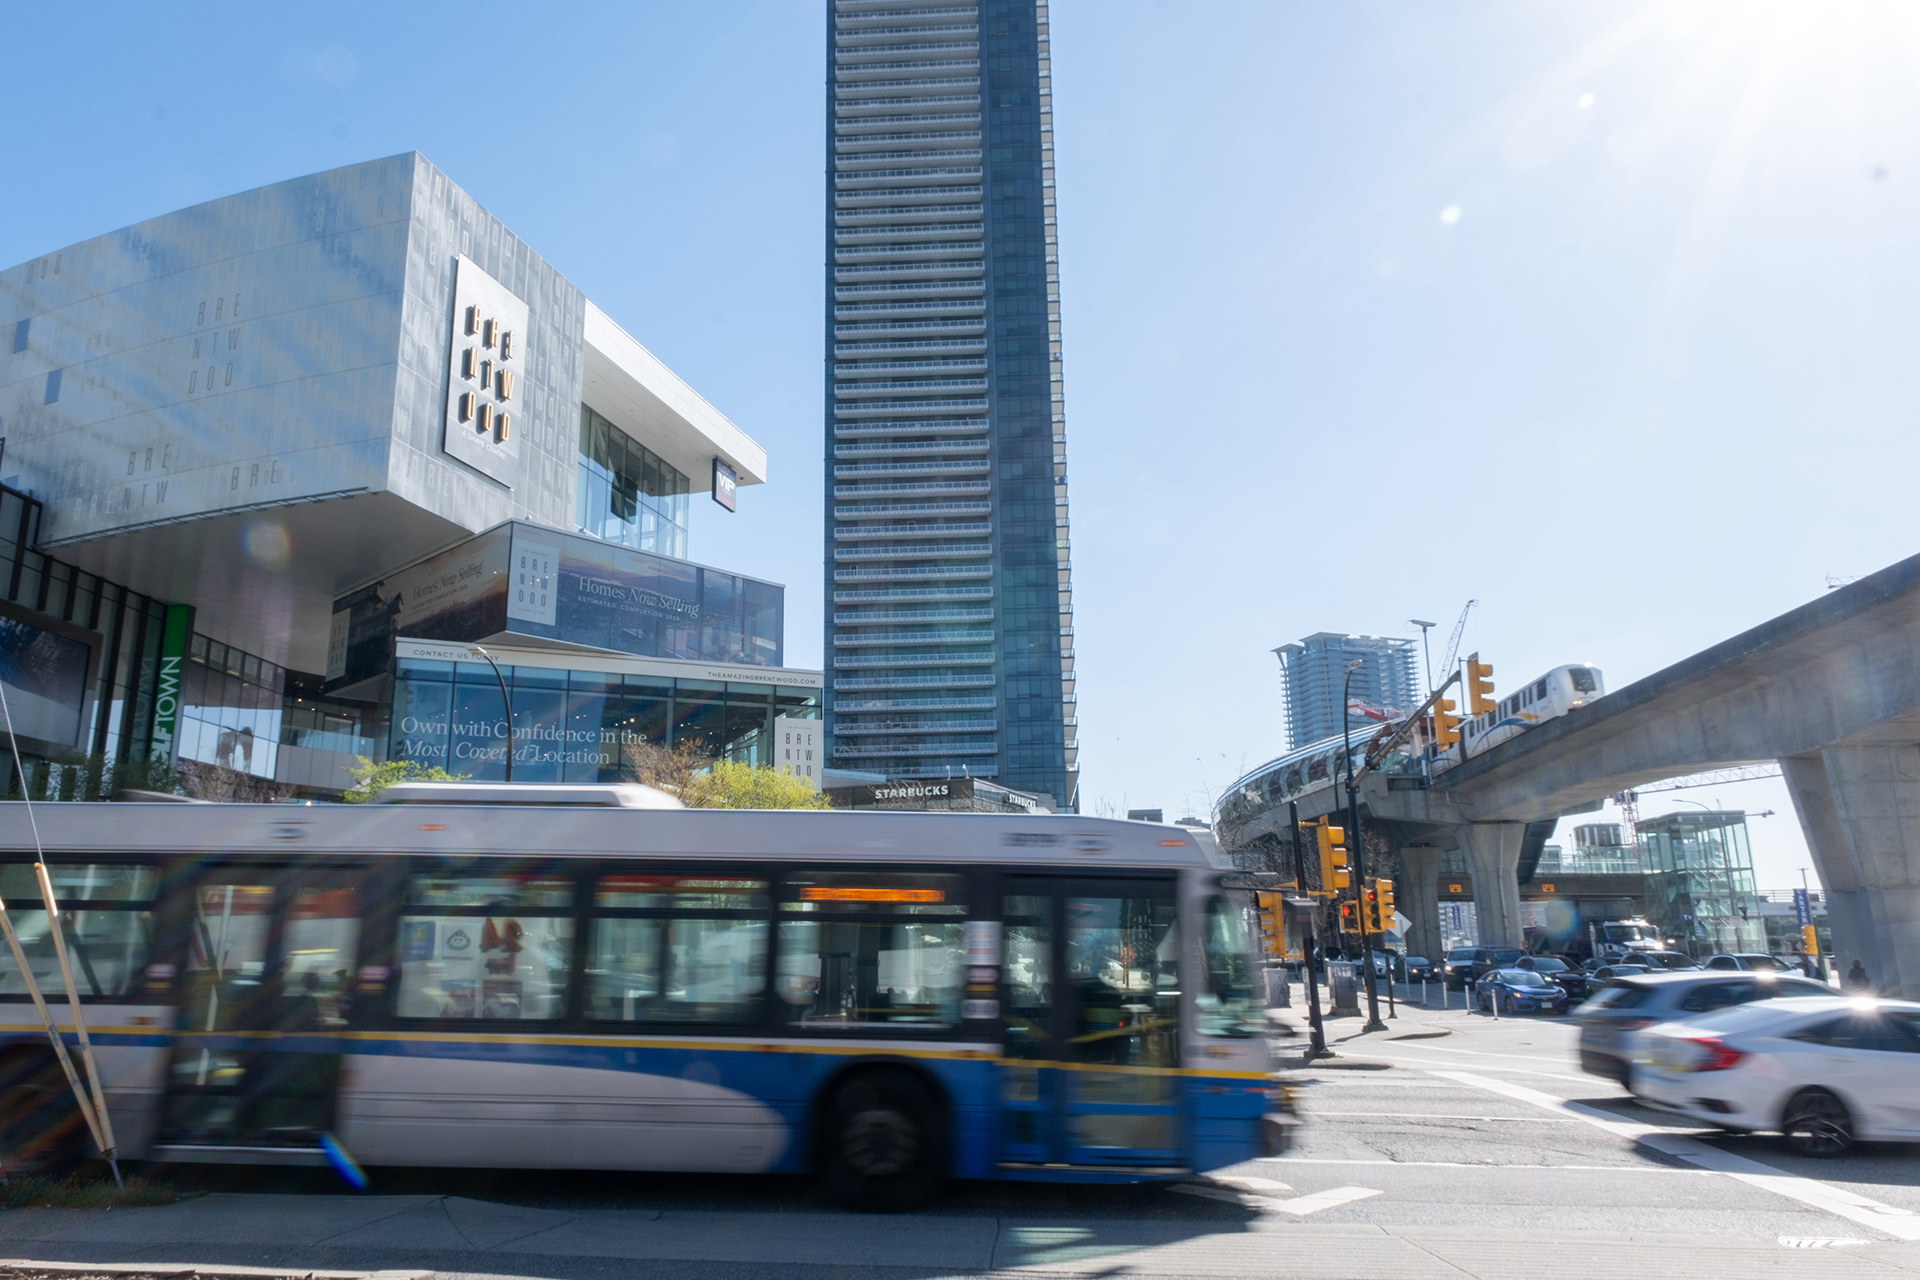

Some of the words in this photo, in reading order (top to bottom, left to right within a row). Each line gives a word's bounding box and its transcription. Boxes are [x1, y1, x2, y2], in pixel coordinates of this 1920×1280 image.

[197, 293, 241, 325] BRE
[192, 327, 240, 359] NTW
[472, 304, 515, 360] BRE
[188, 362, 234, 394] OOD
[469, 346, 515, 401] NTW
[467, 390, 511, 442] OOD
[127, 443, 170, 476] BRE
[231, 459, 278, 491] BRE
[718, 472, 735, 492] VIP
[123, 480, 169, 510] NTW
[520, 556, 548, 574] BRE
[519, 573, 549, 590] NTW
[518, 589, 547, 607] OOD
[577, 595, 617, 609] ESTIMATED
[620, 604, 663, 619] COMPLETION
[579, 577, 626, 600] Homes
[628, 588, 658, 606] Now
[658, 594, 700, 619] Selling
[413, 649, 453, 658] CONTACT
[708, 671, 816, 685] THEAMAZINGBRENTWOOD.COM
[401, 716, 448, 735] Own
[452, 720, 491, 738] with
[494, 722, 596, 743] Confidence
[600, 727, 616, 744] in
[620, 729, 647, 745] the
[785, 733, 812, 746] BRE
[401, 740, 448, 758] Most
[534, 745, 610, 765] Location
[785, 748, 813, 761] NTW
[875, 785, 949, 799] STARBUCKS
[1009, 793, 1037, 808] STARBUCKS
